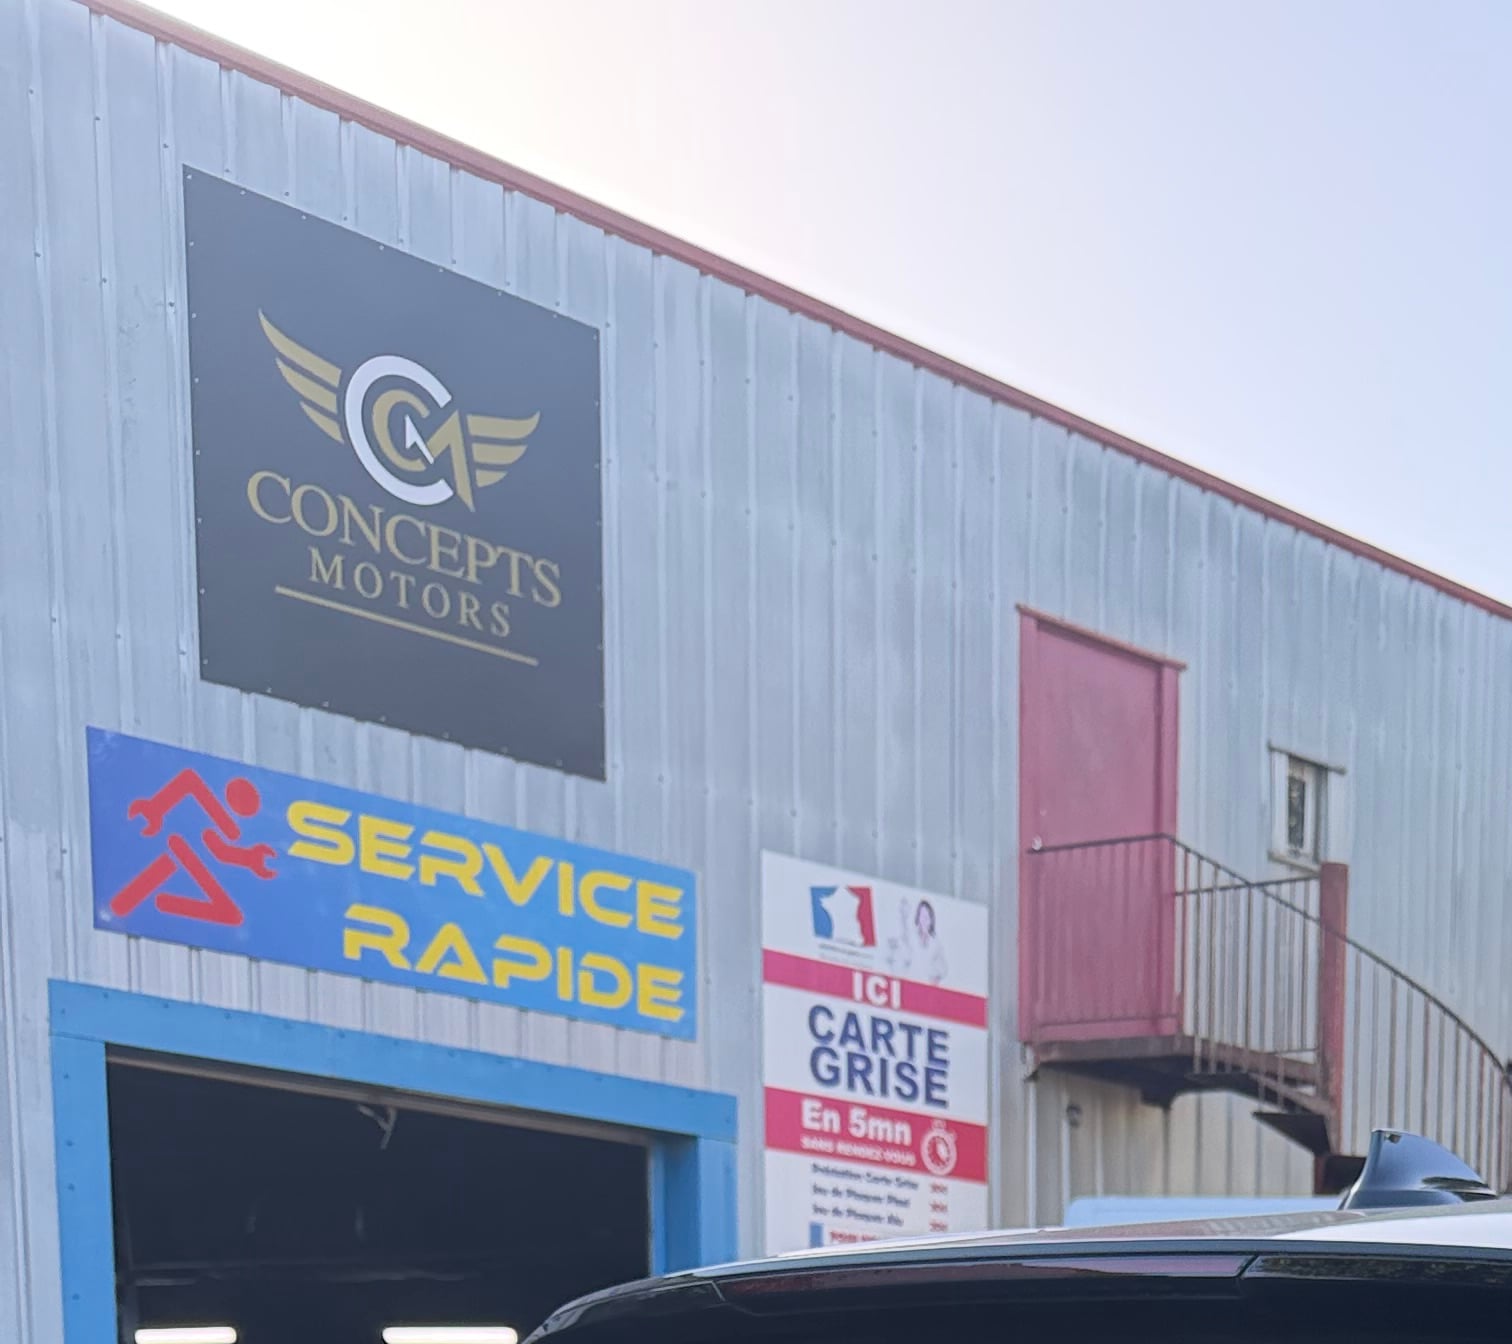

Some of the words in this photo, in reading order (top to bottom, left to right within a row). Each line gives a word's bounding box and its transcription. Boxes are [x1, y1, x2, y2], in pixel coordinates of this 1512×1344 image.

[247, 470, 562, 608] CONCEPTS
[308, 546, 511, 637] MOTORS
[287, 801, 684, 939] SERVICE
[344, 904, 685, 1021] RAPIDE
[852, 970, 902, 1010] ICI
[808, 1004, 950, 1067] CARTE
[810, 1046, 949, 1109] GRISE
[802, 1099, 841, 1134] En
[848, 1106, 912, 1146] 5mn
